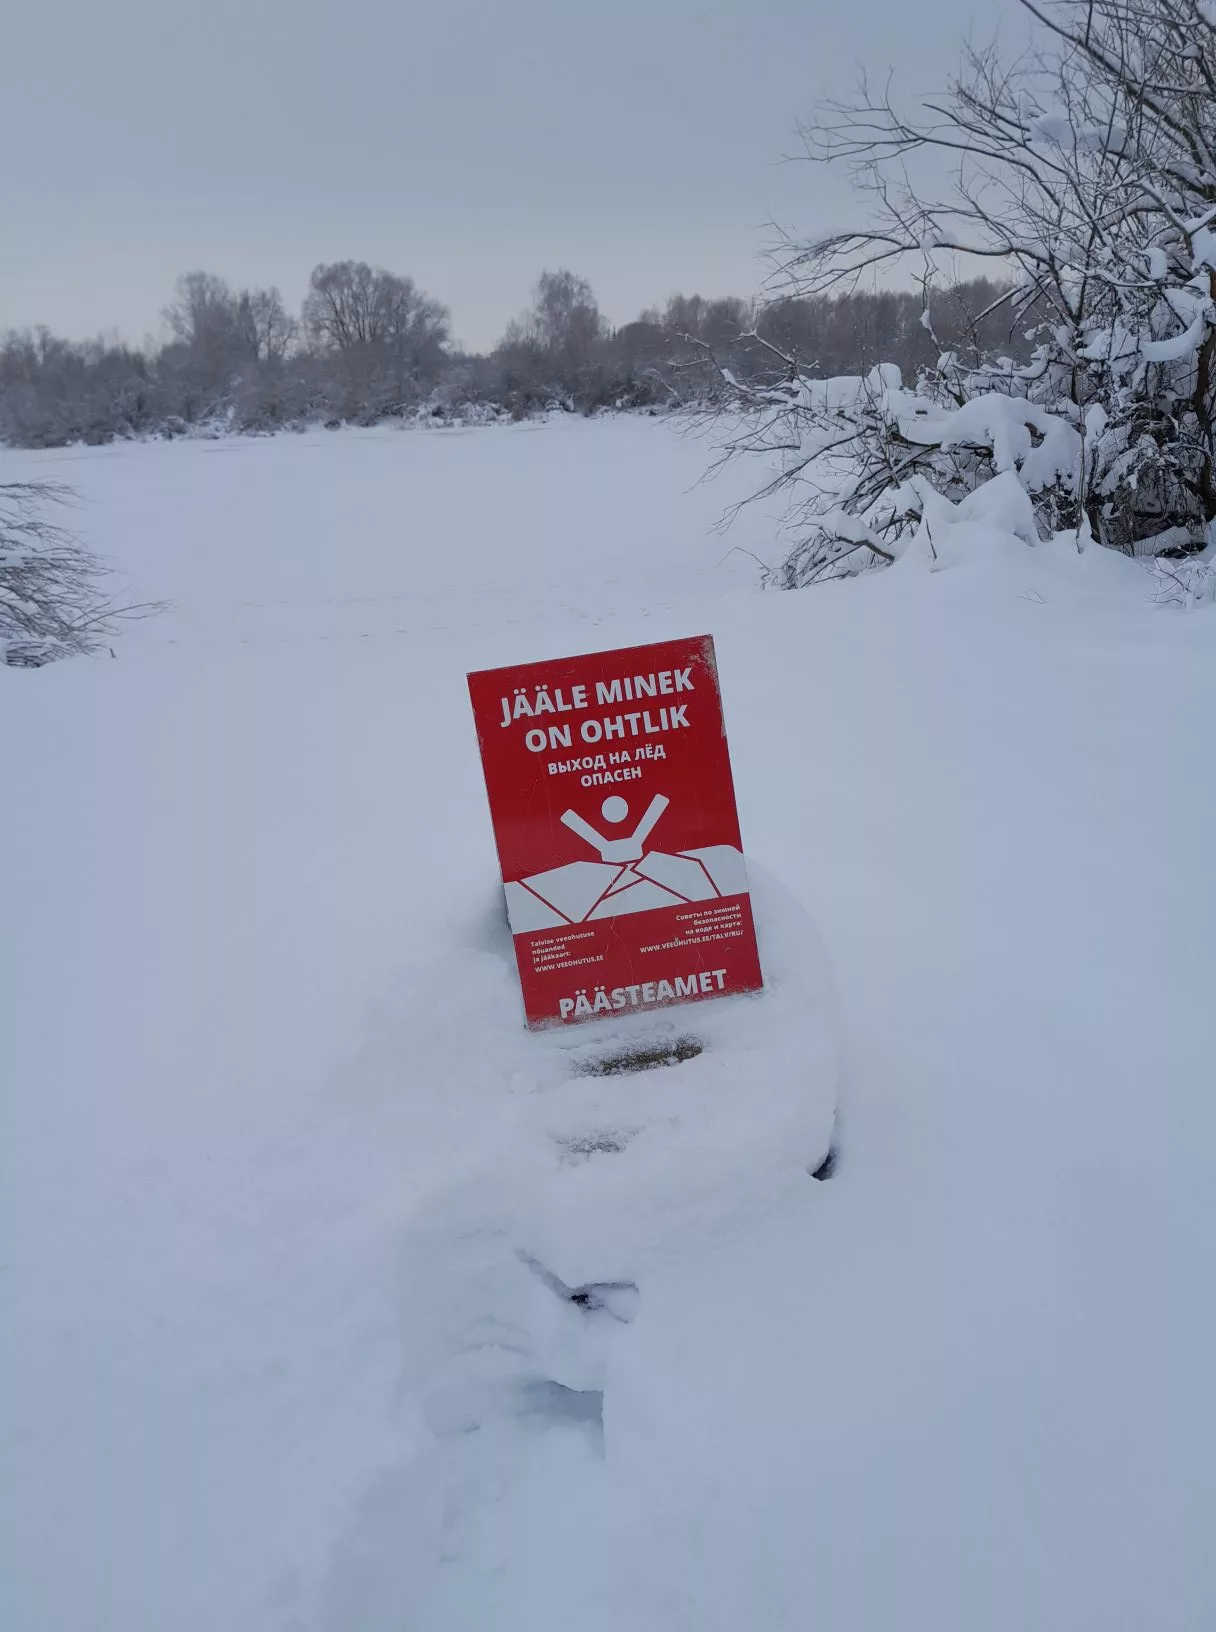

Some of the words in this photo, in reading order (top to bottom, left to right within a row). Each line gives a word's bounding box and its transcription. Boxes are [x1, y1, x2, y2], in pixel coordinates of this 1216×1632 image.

[500, 684, 588, 728] JÄÄLE
[595, 667, 695, 705] MINEK
[525, 724, 573, 752] ON
[581, 704, 690, 743] OHTLIK
[548, 755, 607, 775] ВЫХОД
[609, 750, 631, 765] НА
[634, 744, 666, 761] ЛЁД
[581, 766, 642, 787] ОПАСЕН
[676, 911, 703, 921] Советы
[713, 904, 740, 915] зимней
[693, 912, 742, 926] безопасности
[695, 925, 713, 934] воде
[531, 937, 554, 947] Talvise
[556, 931, 595, 943] veeohutuse
[639, 929, 744, 954] WWW.VEEOHUTUS.EE/TALV/RU/
[532, 944, 565, 955] nõuanded
[533, 955, 540, 963] ja
[535, 955, 604, 972] WWW.VEEOHUTUS.EE
[559, 969, 727, 1019] PÄÄSTEAMET
